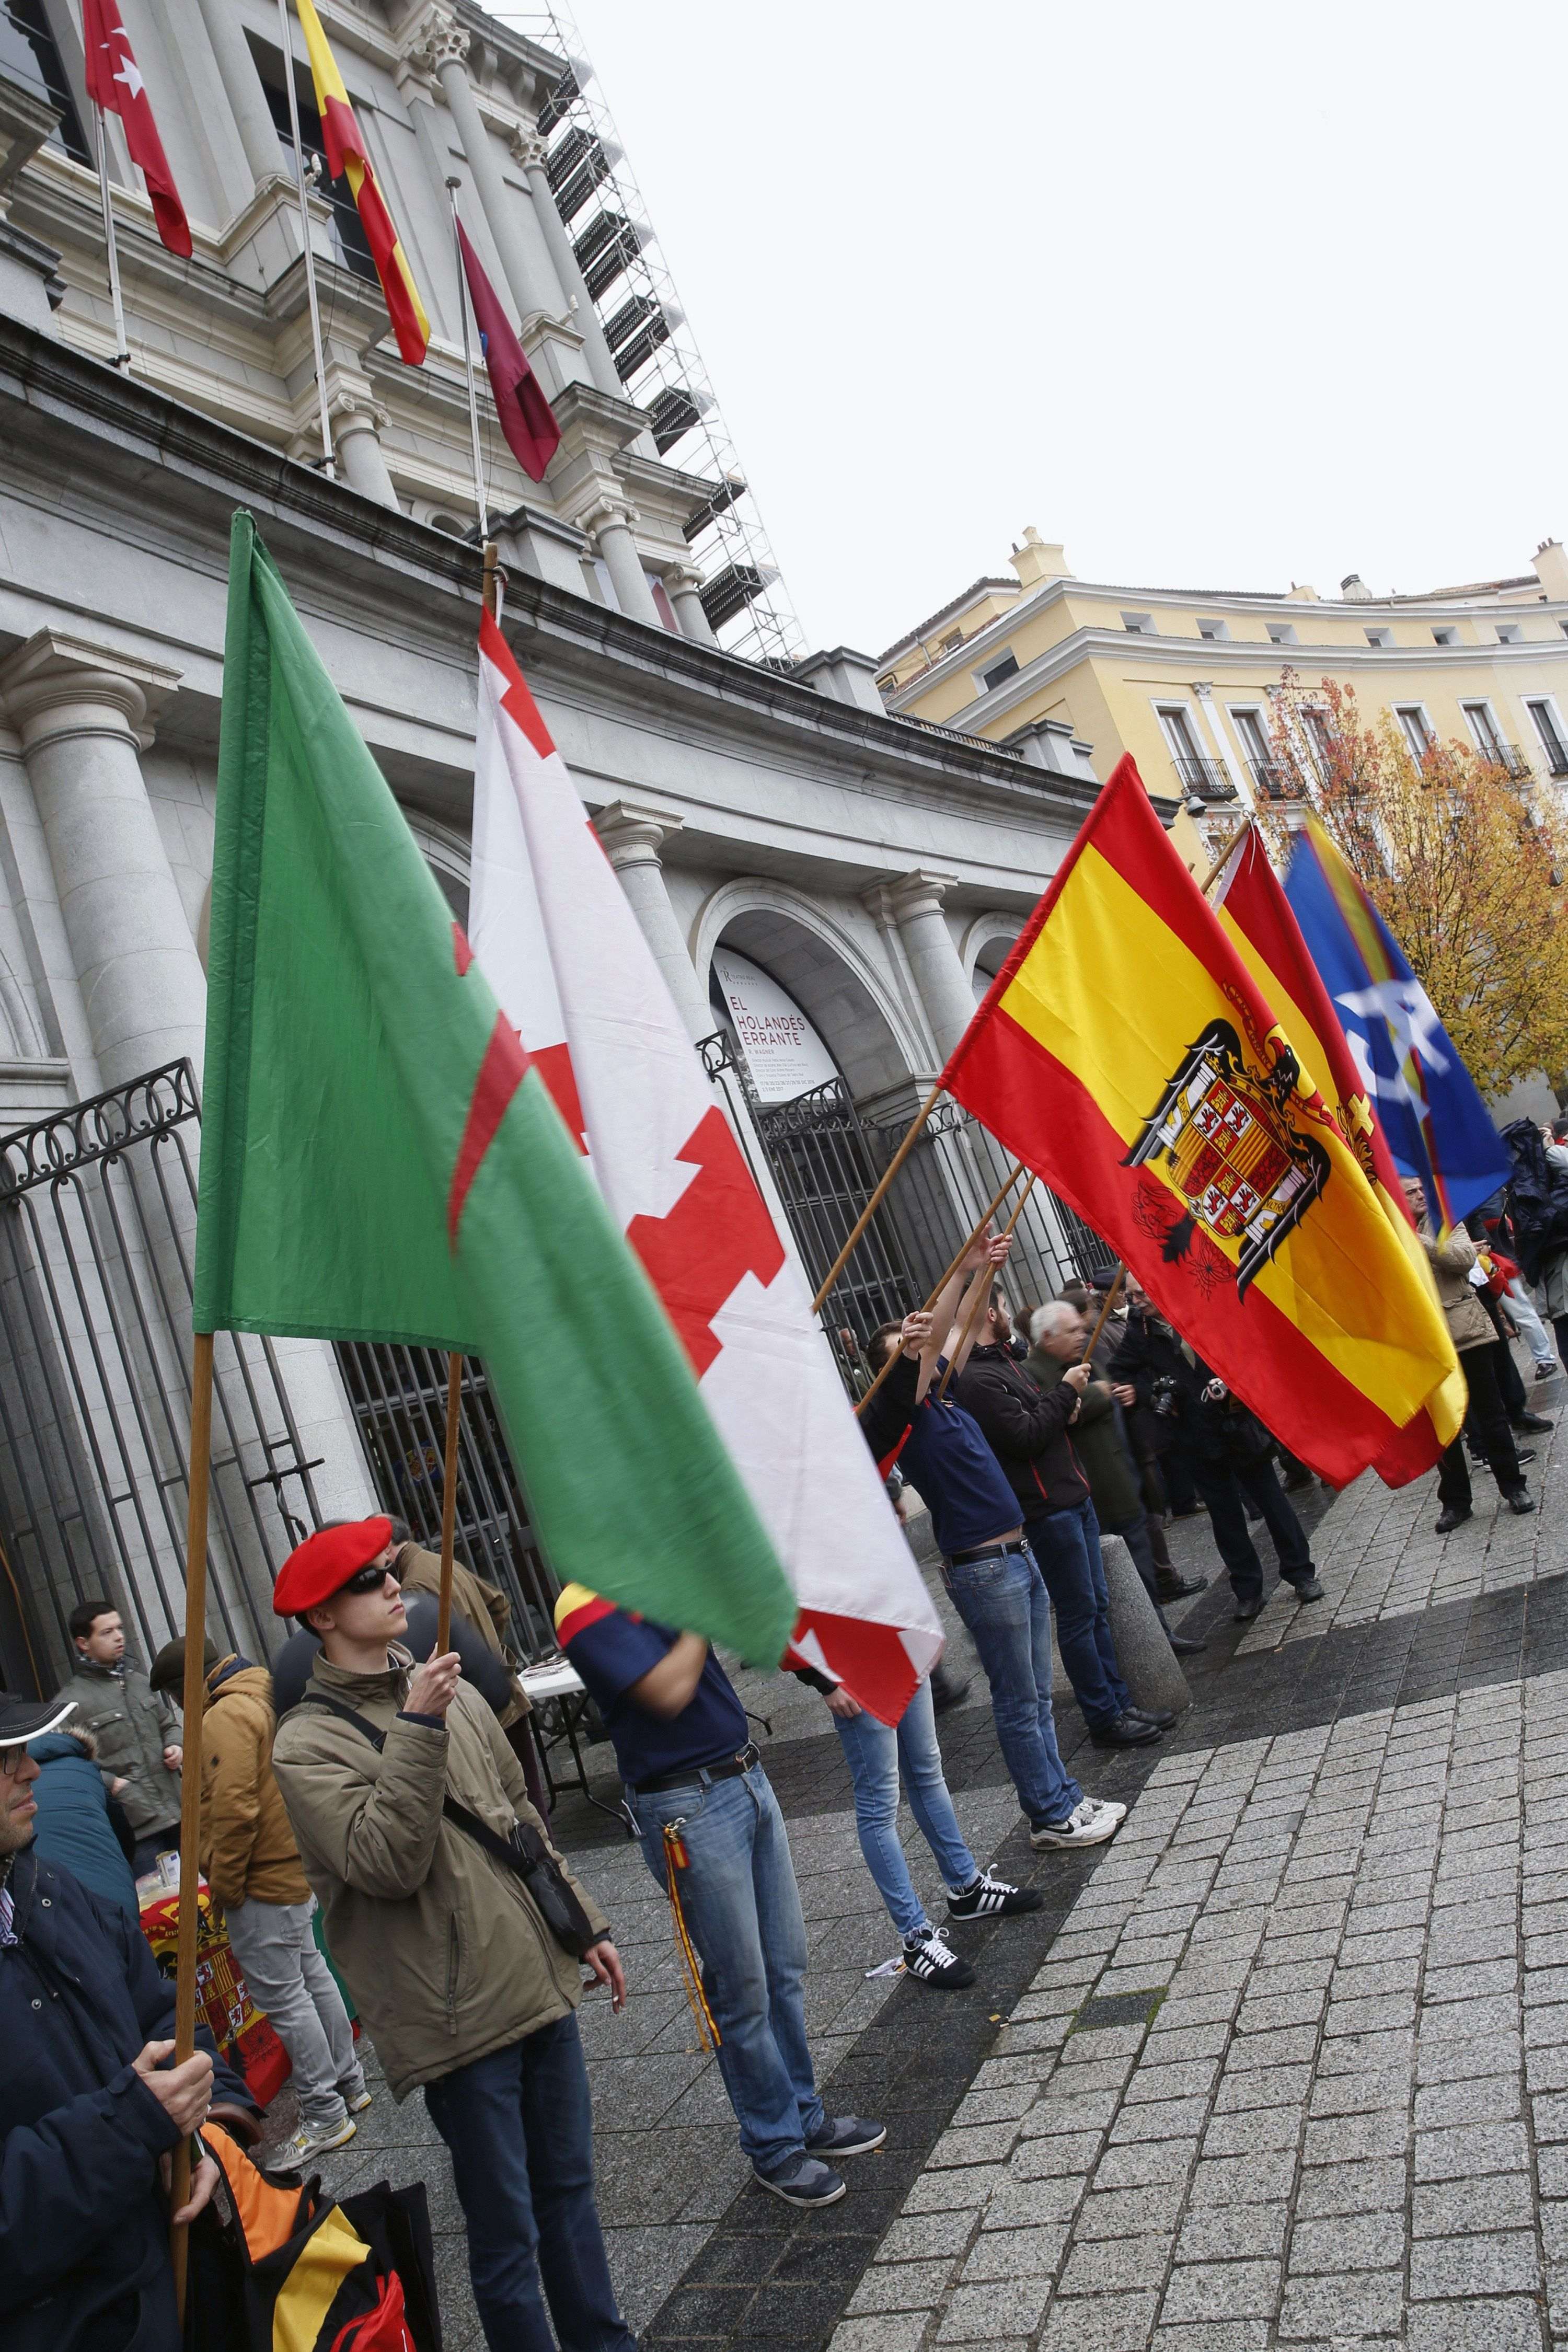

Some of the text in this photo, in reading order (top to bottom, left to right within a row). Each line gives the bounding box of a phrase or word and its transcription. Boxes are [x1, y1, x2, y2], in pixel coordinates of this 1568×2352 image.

[730, 996, 747, 1010] EL
[736, 1014, 805, 1030] HOLANDÉS
[742, 1032, 802, 1045] ERRANTE
